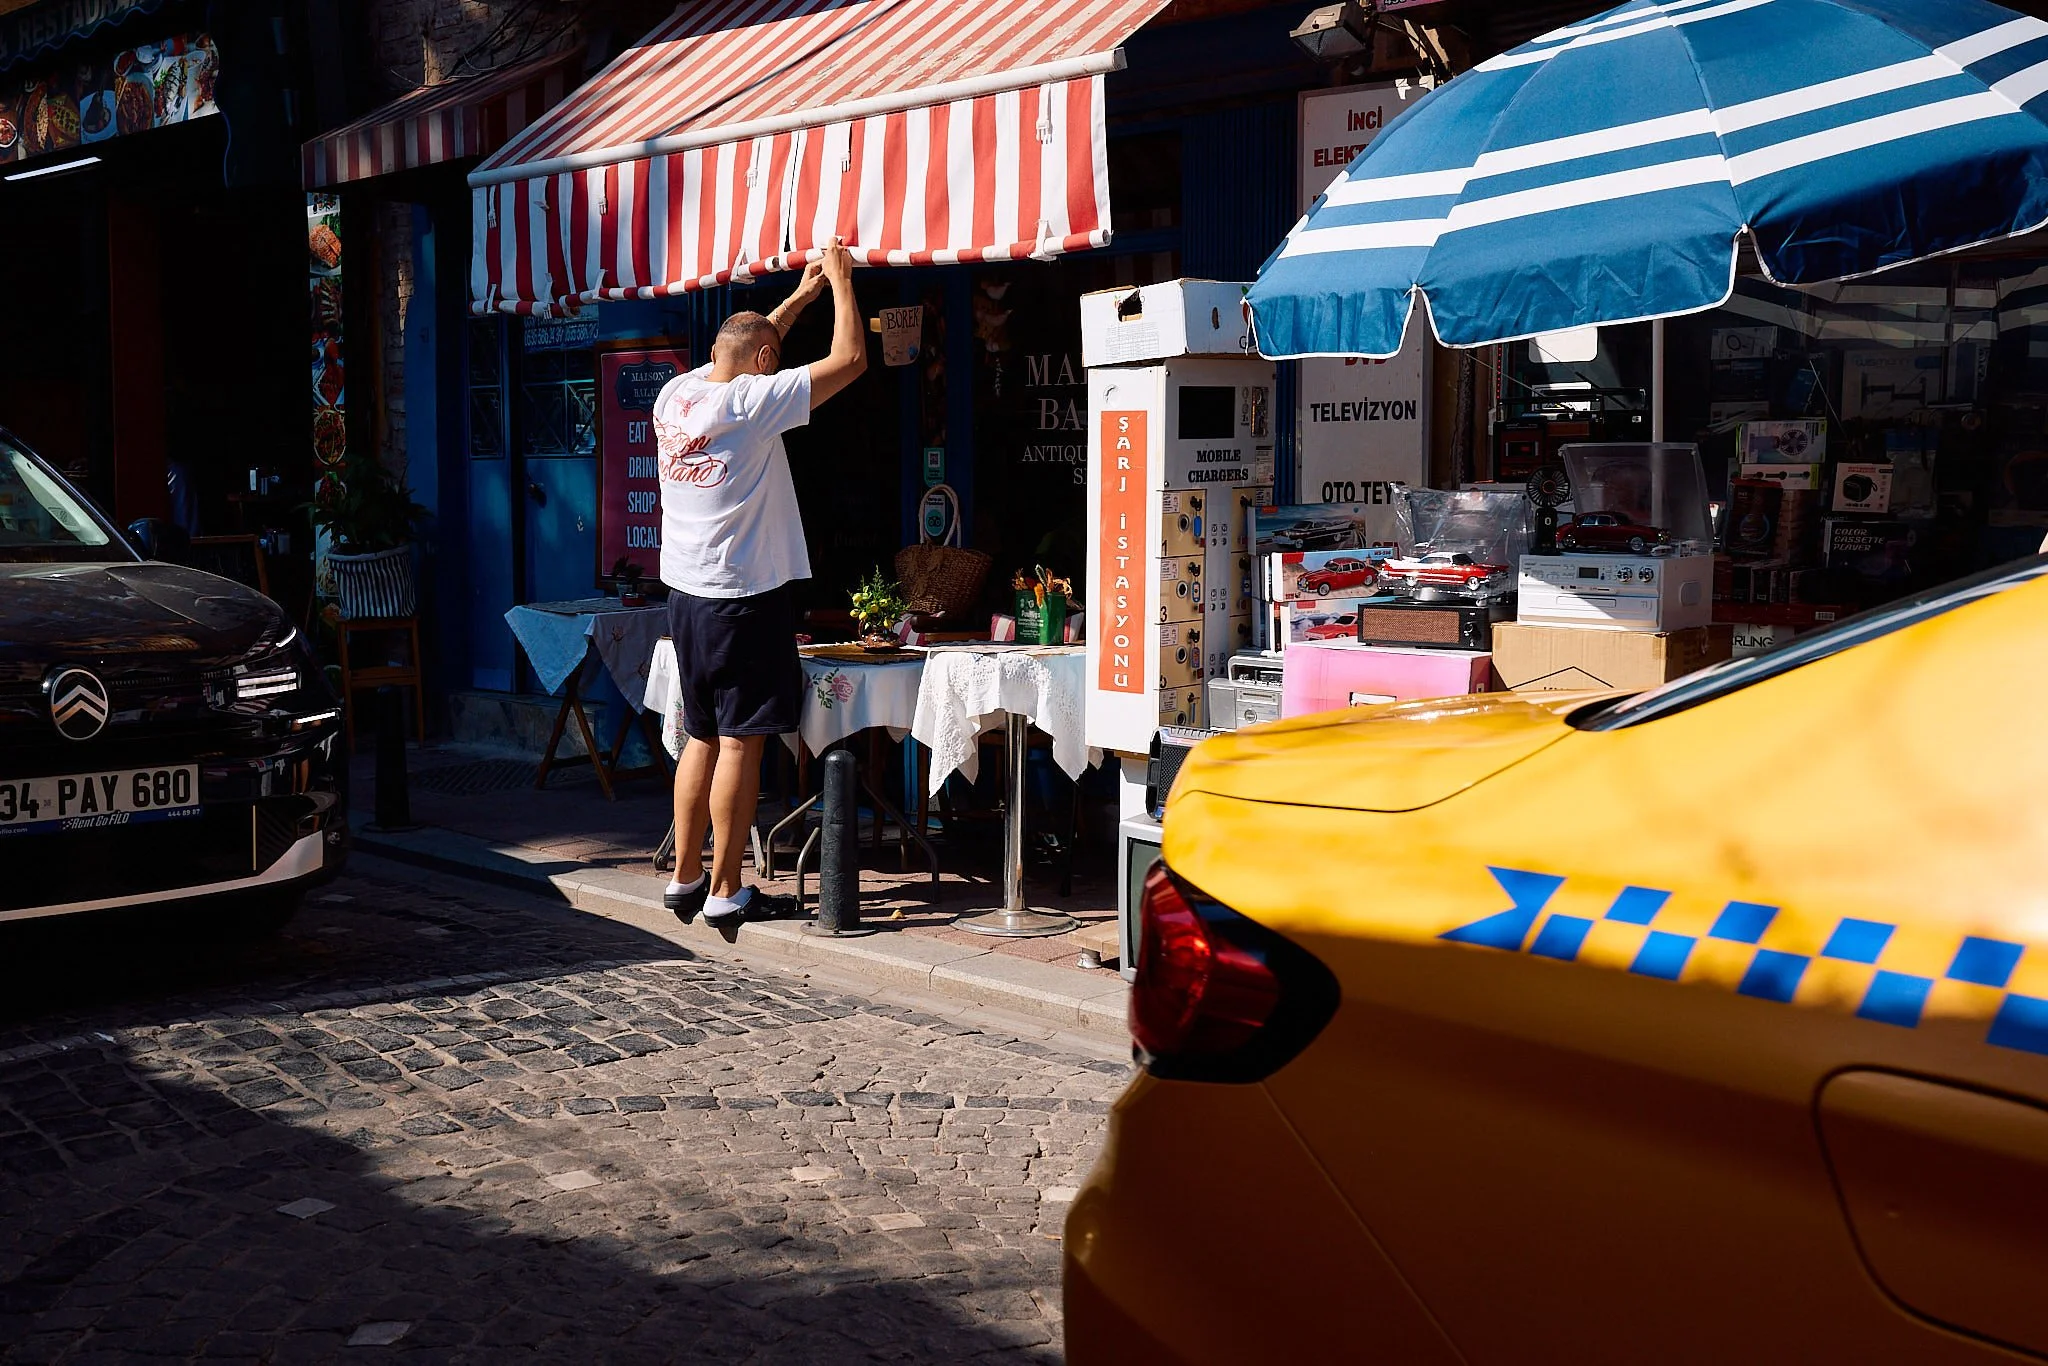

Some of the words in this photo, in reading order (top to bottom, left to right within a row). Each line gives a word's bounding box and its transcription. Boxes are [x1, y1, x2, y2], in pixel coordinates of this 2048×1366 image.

[1348, 106, 1383, 131] İNCİ
[887, 308, 919, 329] BÖREK
[632, 371, 665, 382] MAISON
[1311, 397, 1417, 422] TELEVİZYON
[628, 421, 648, 443] EAT
[1116, 416, 1131, 492] ŞARJ
[1197, 449, 1241, 463] MOBILE
[1188, 468, 1249, 483] CHARGERS
[1322, 481, 1356, 503] OTO
[627, 491, 657, 514] SHOP
[1833, 535, 1885, 545] CASSETTE
[1834, 528, 1868, 536] COLOR
[1160, 606, 1168, 622] 3
[1732, 635, 1775, 647] RLING
[0, 782, 40, 821] 34
[58, 775, 118, 816] PAY
[132, 769, 191, 808] 680
[167, 809, 182, 818] 444
[71, 817, 95, 830] Rent
